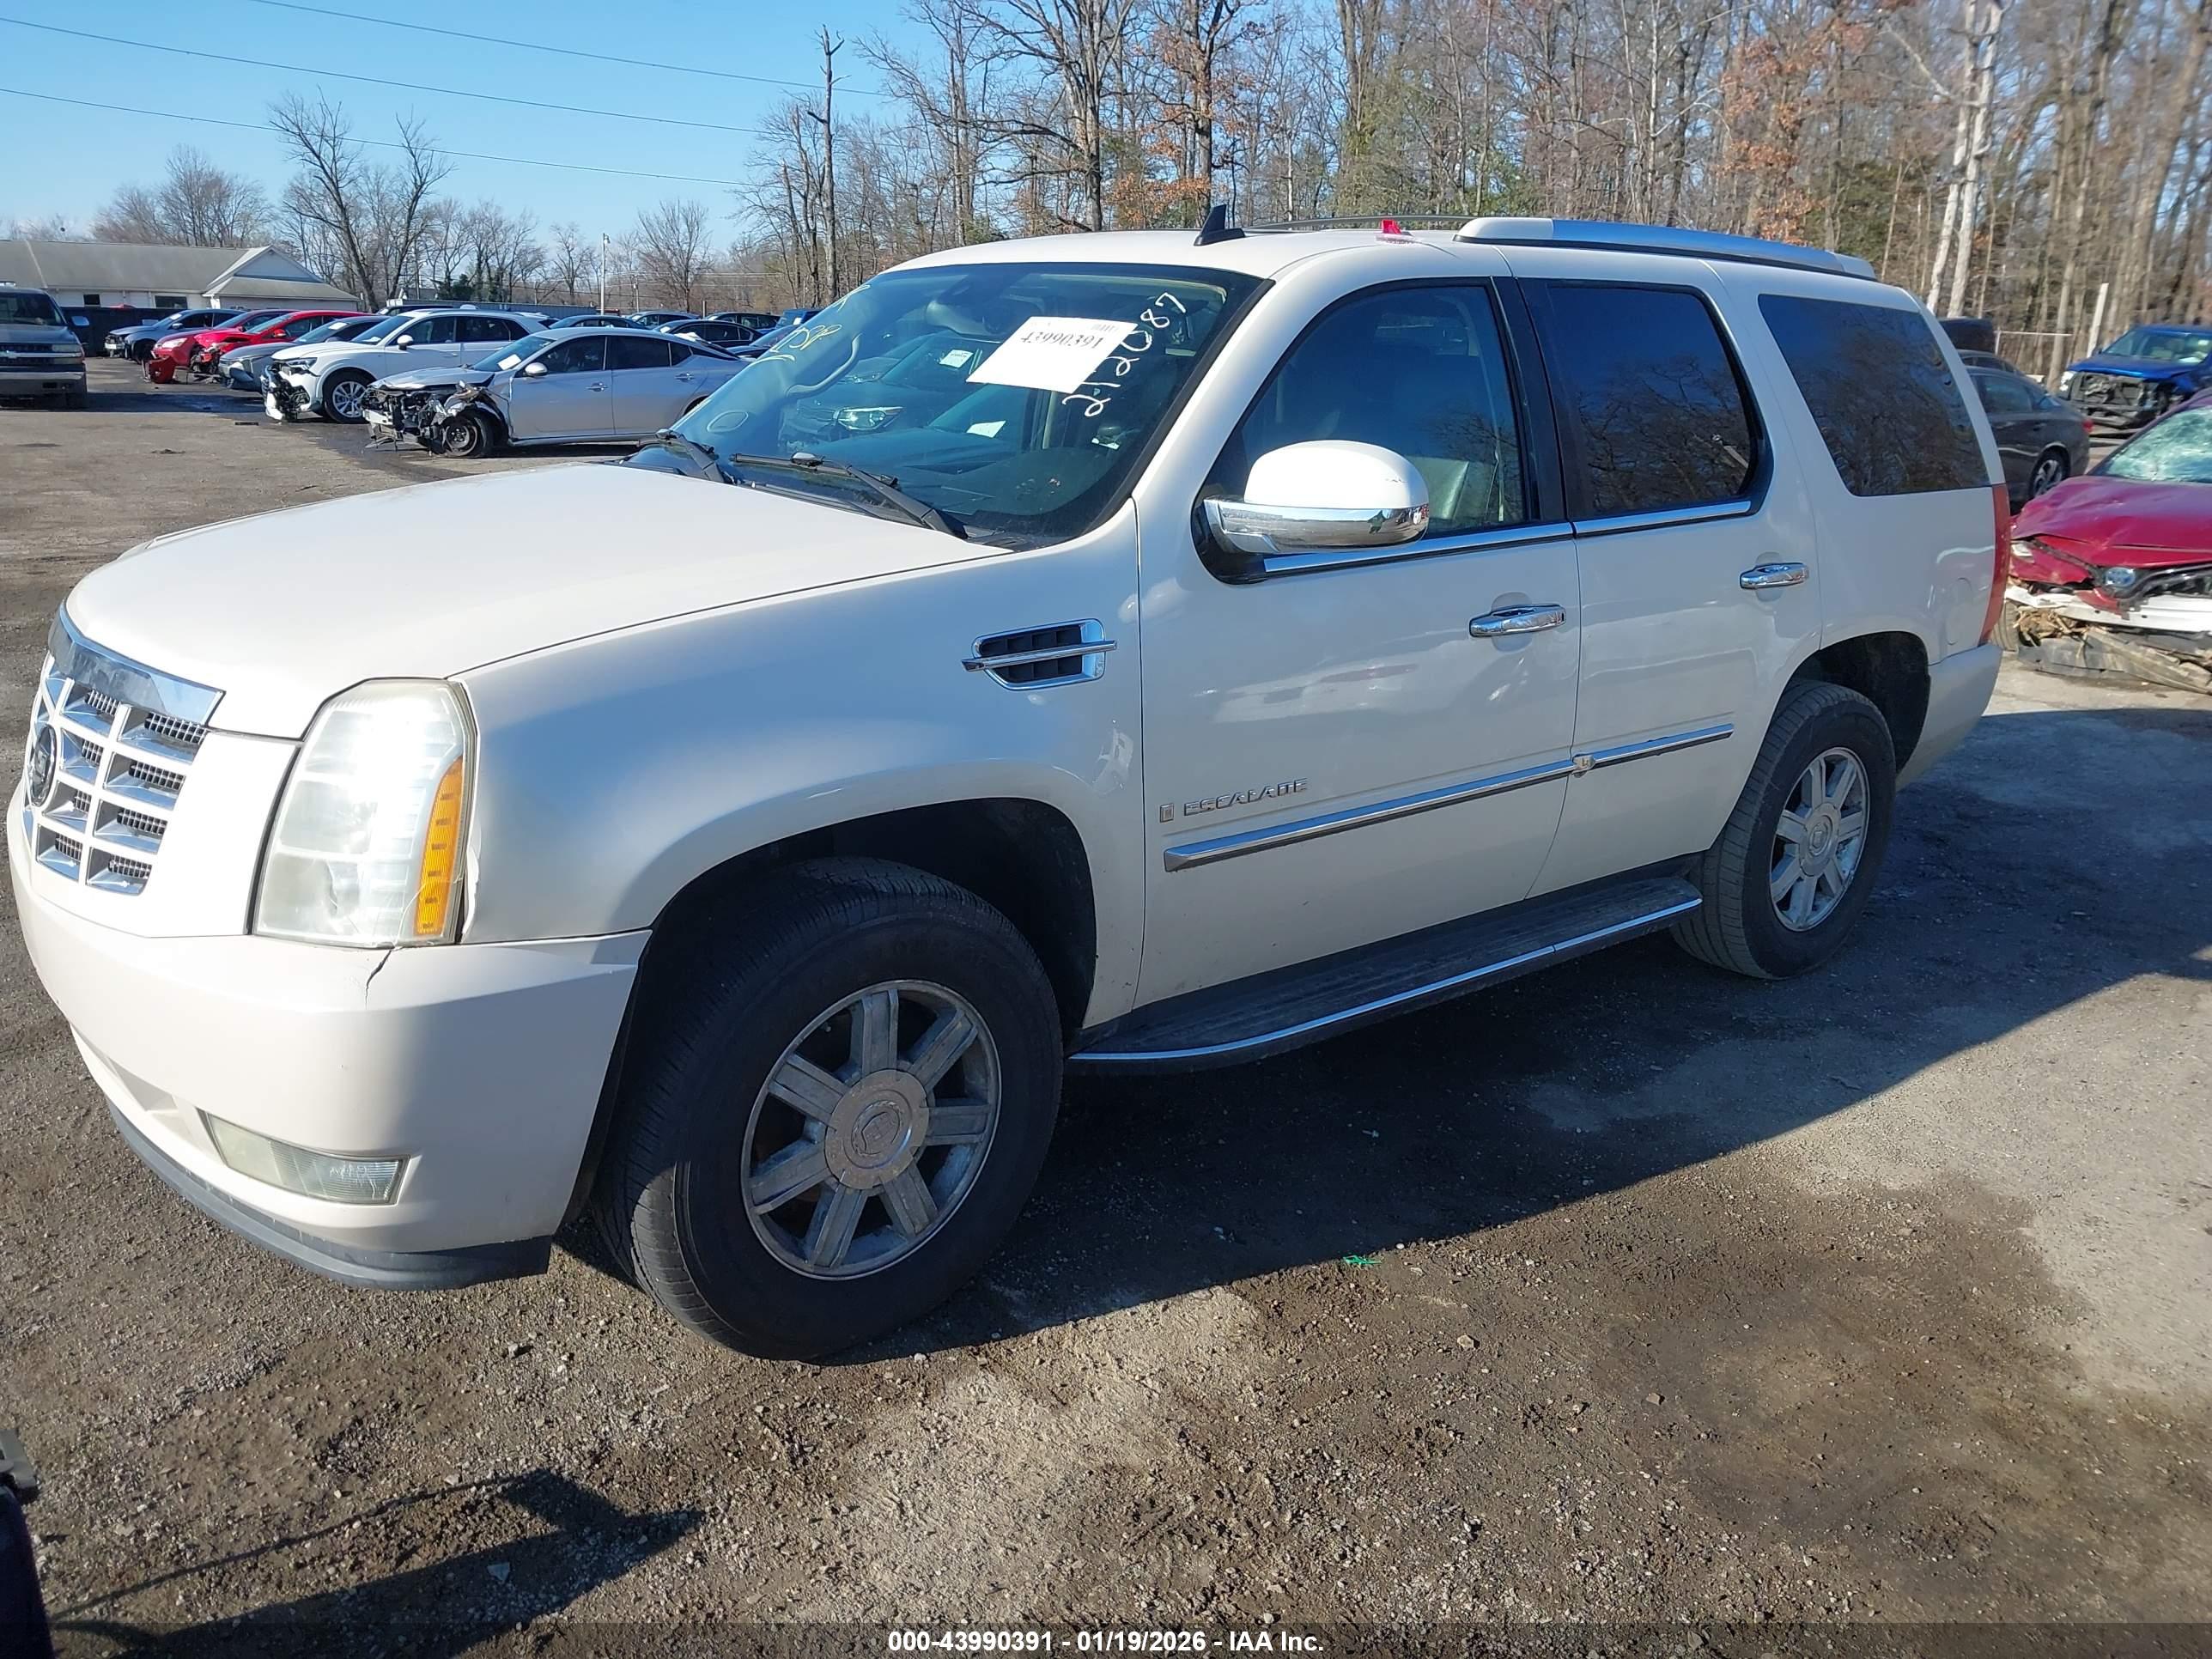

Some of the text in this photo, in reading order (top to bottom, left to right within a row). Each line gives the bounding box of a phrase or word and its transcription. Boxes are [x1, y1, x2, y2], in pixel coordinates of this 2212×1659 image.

[1020, 331, 1104, 349] 43990391
[1061, 292, 1187, 417] 212087
[1183, 777, 1308, 817] ESCALADE
